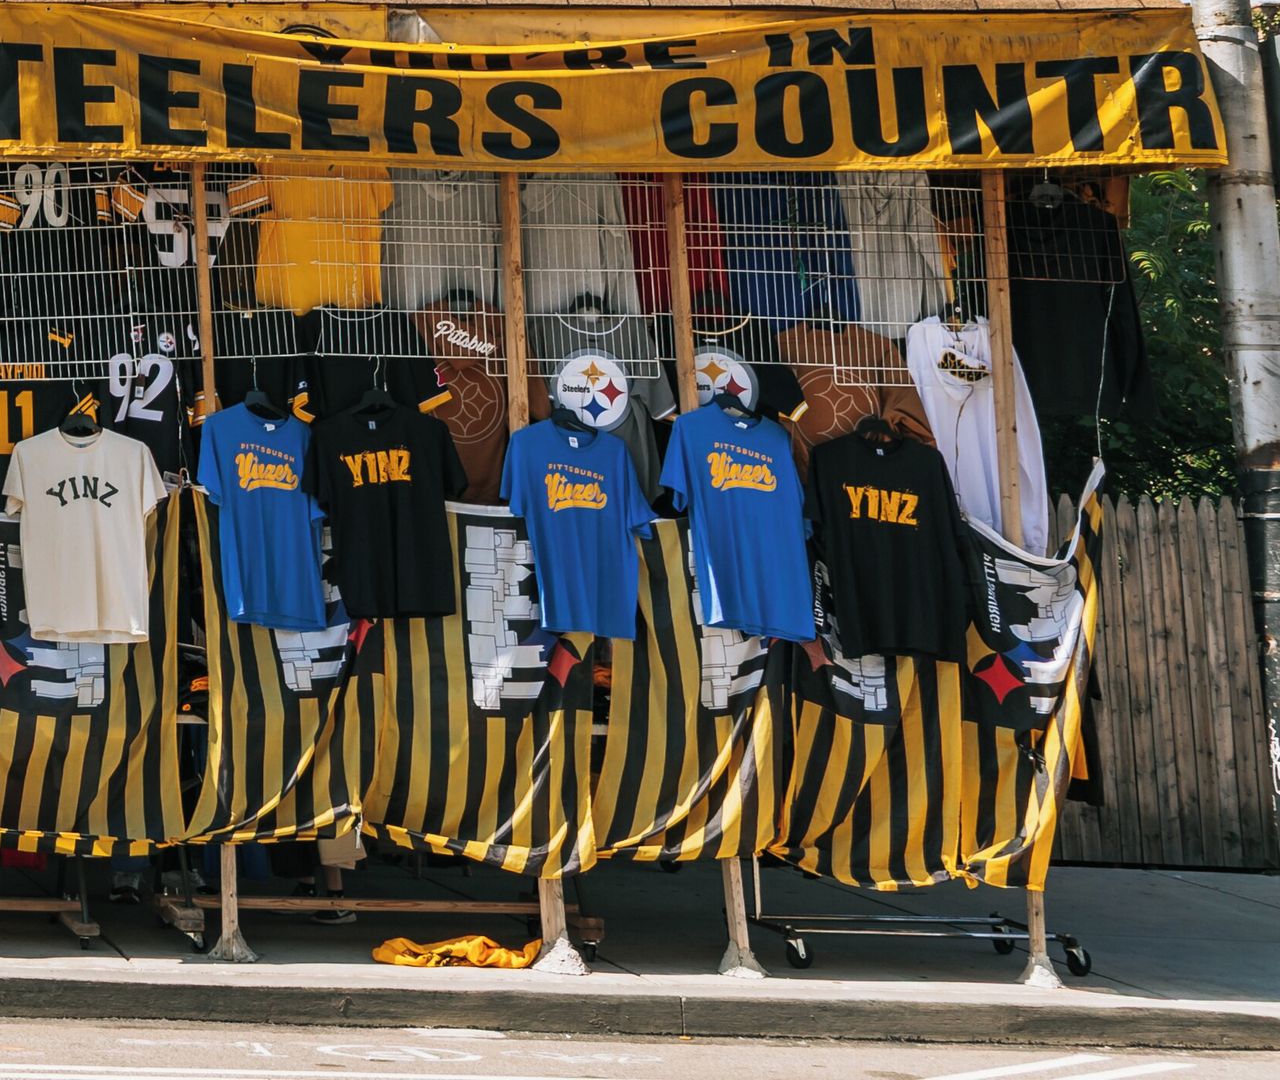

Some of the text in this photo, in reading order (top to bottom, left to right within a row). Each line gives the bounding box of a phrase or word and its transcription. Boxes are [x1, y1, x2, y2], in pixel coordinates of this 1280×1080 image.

[14, 163, 70, 229] 90
[108, 353, 174, 423] 92
[562, 383, 591, 394] Steelers
[235, 452, 299, 492] Yinzer
[240, 443, 295, 463] PITTSBURGH
[342, 446, 412, 488] YINZ
[548, 463, 605, 482] PITTSBURGH
[706, 452, 778, 492] Yinzer
[713, 441, 774, 464] PITTSBURGH
[44, 475, 120, 509] YINZ
[544, 472, 608, 512] Yinzer
[844, 484, 920, 527] YINZ
